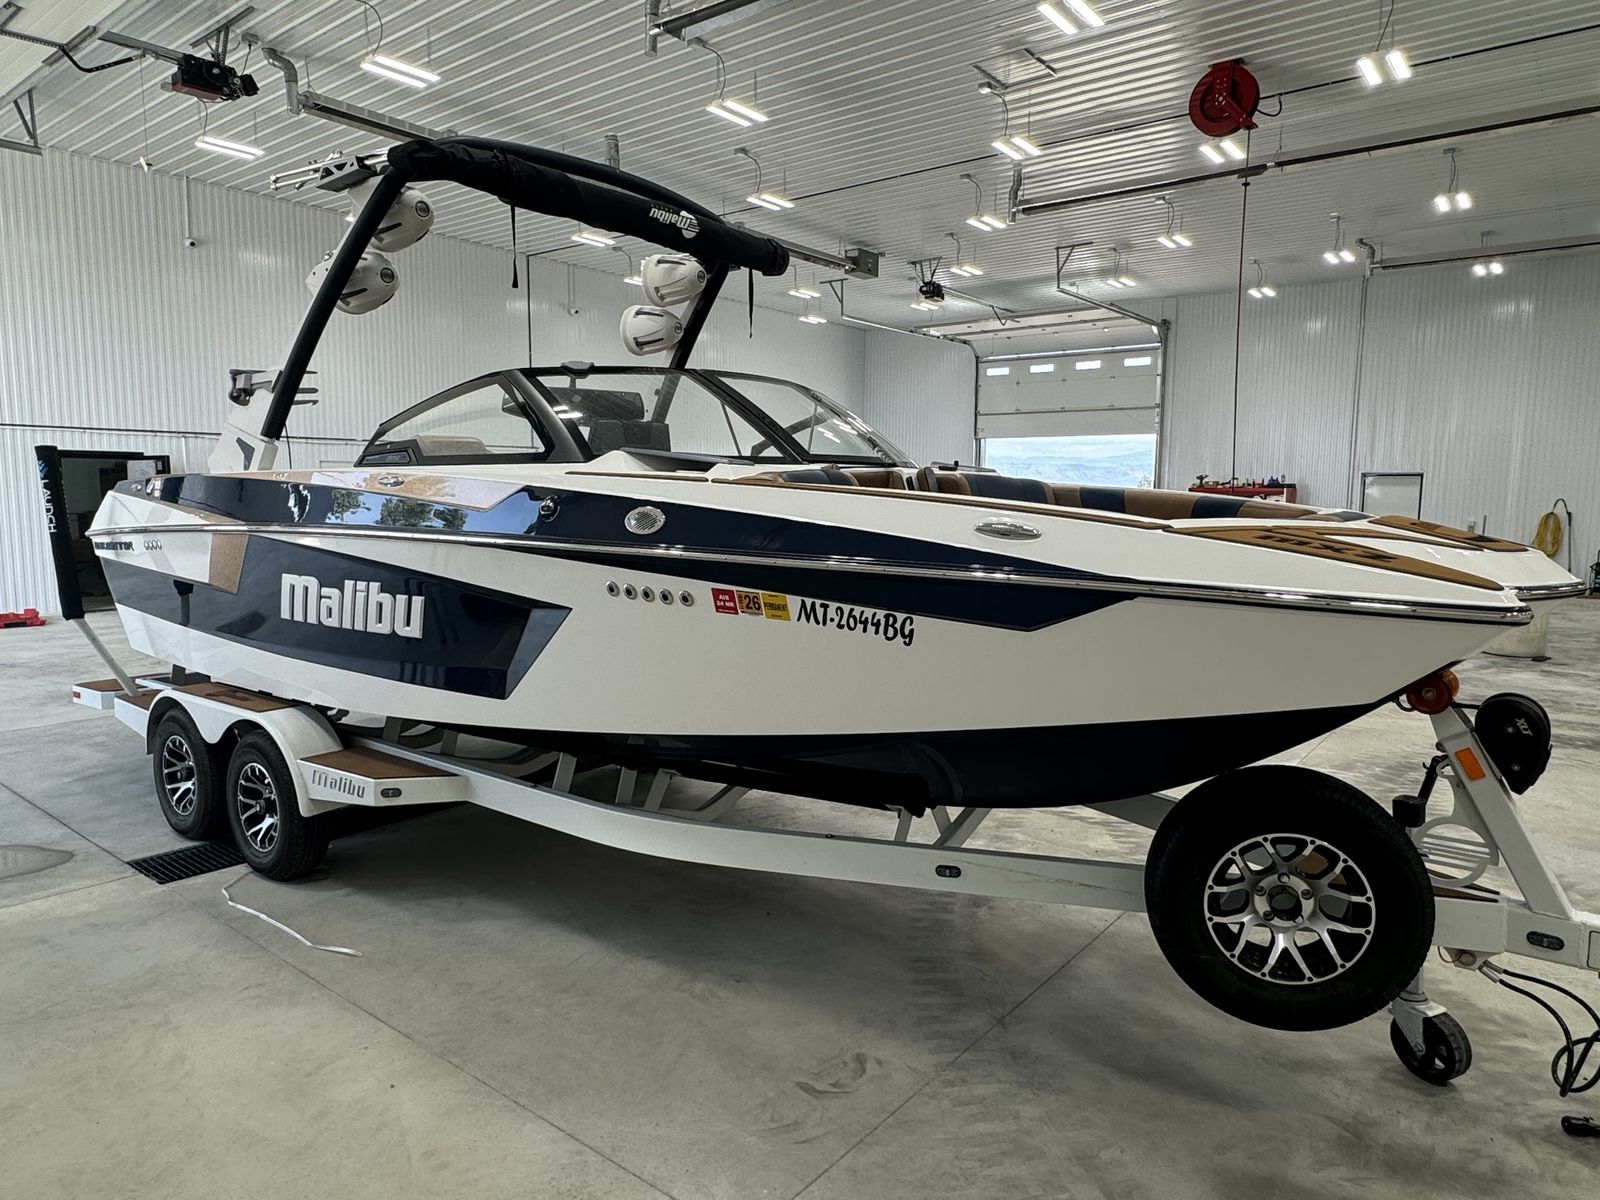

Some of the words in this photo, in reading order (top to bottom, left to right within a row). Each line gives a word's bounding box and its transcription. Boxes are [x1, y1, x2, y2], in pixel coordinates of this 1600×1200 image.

[649, 207, 692, 229] Malibu
[41, 479, 57, 533] LAUNCH
[280, 573, 426, 639] Malibu
[743, 594, 761, 611] 26
[312, 769, 366, 799] Malibu
